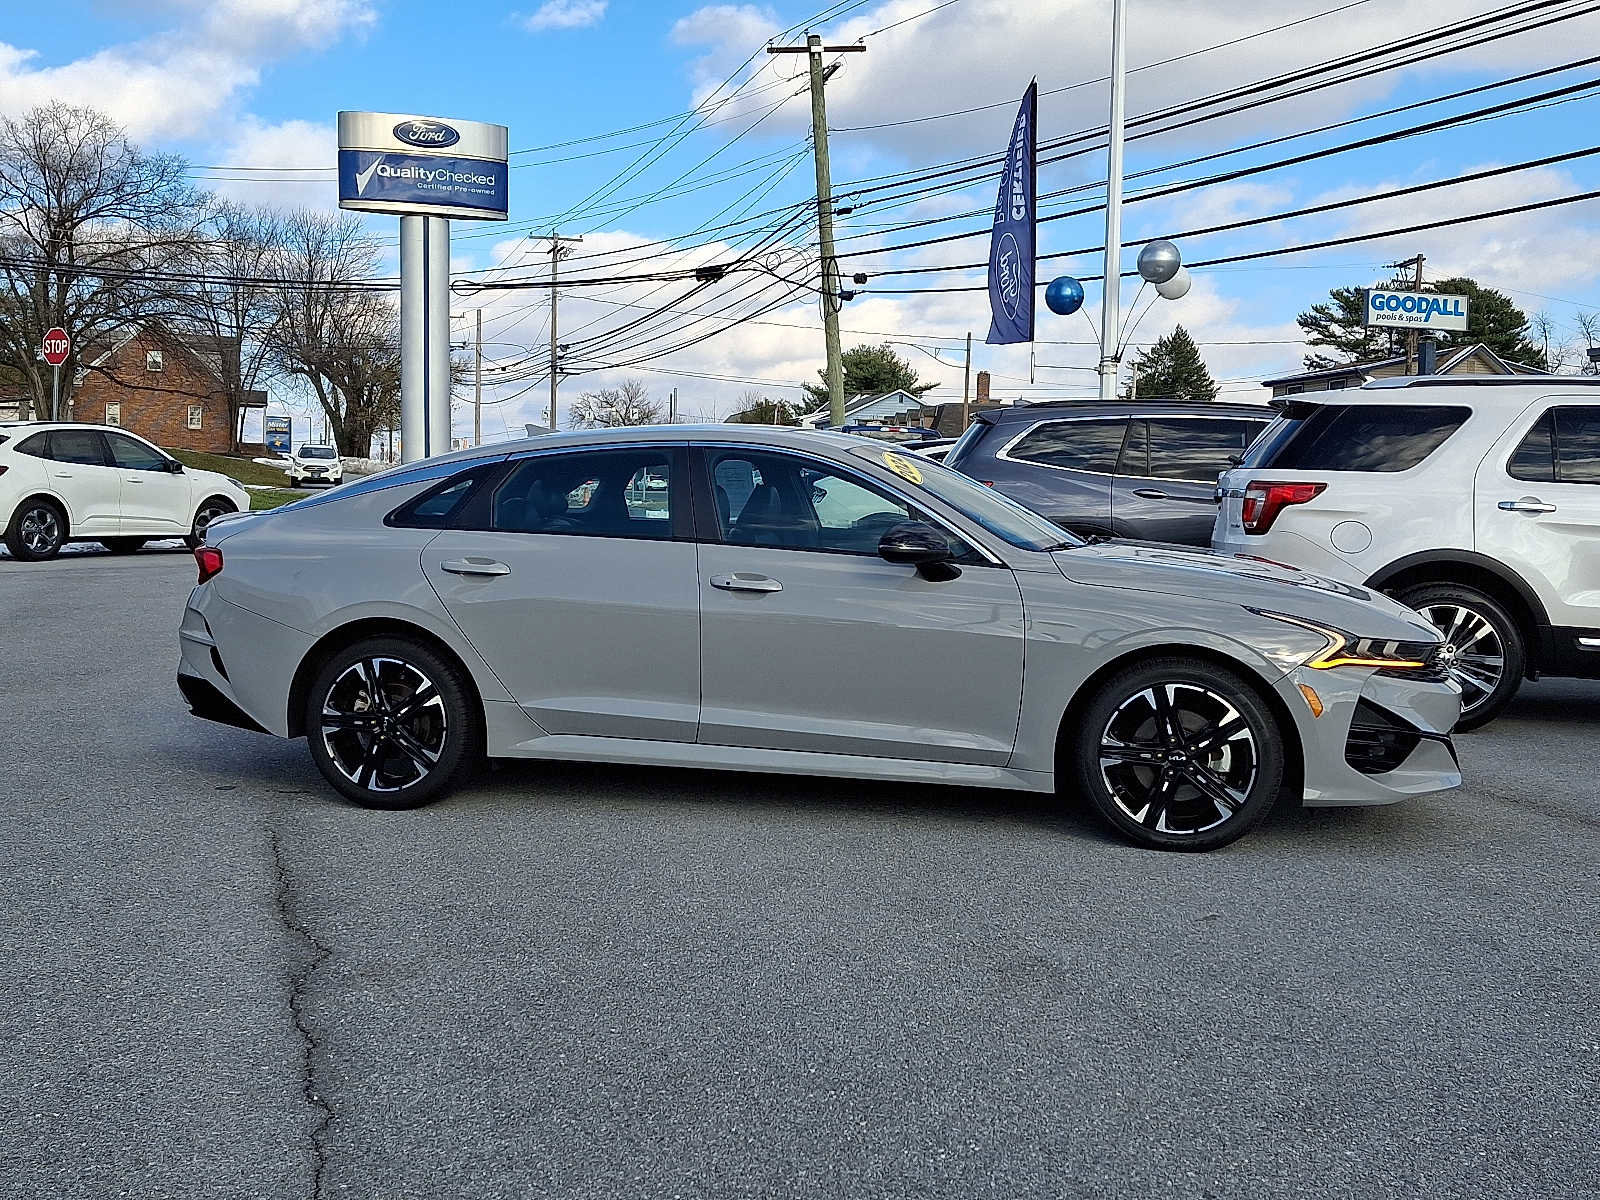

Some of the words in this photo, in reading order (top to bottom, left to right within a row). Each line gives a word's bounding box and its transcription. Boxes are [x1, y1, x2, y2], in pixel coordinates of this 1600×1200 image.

[409, 122, 445, 142] Ford
[417, 182, 452, 191] Certified
[454, 185, 495, 195] Pre-owned
[1371, 294, 1465, 322] GOODALL
[1375, 313, 1397, 322] pools
[1405, 316, 1423, 324] spas
[44, 339, 68, 354] STOP
